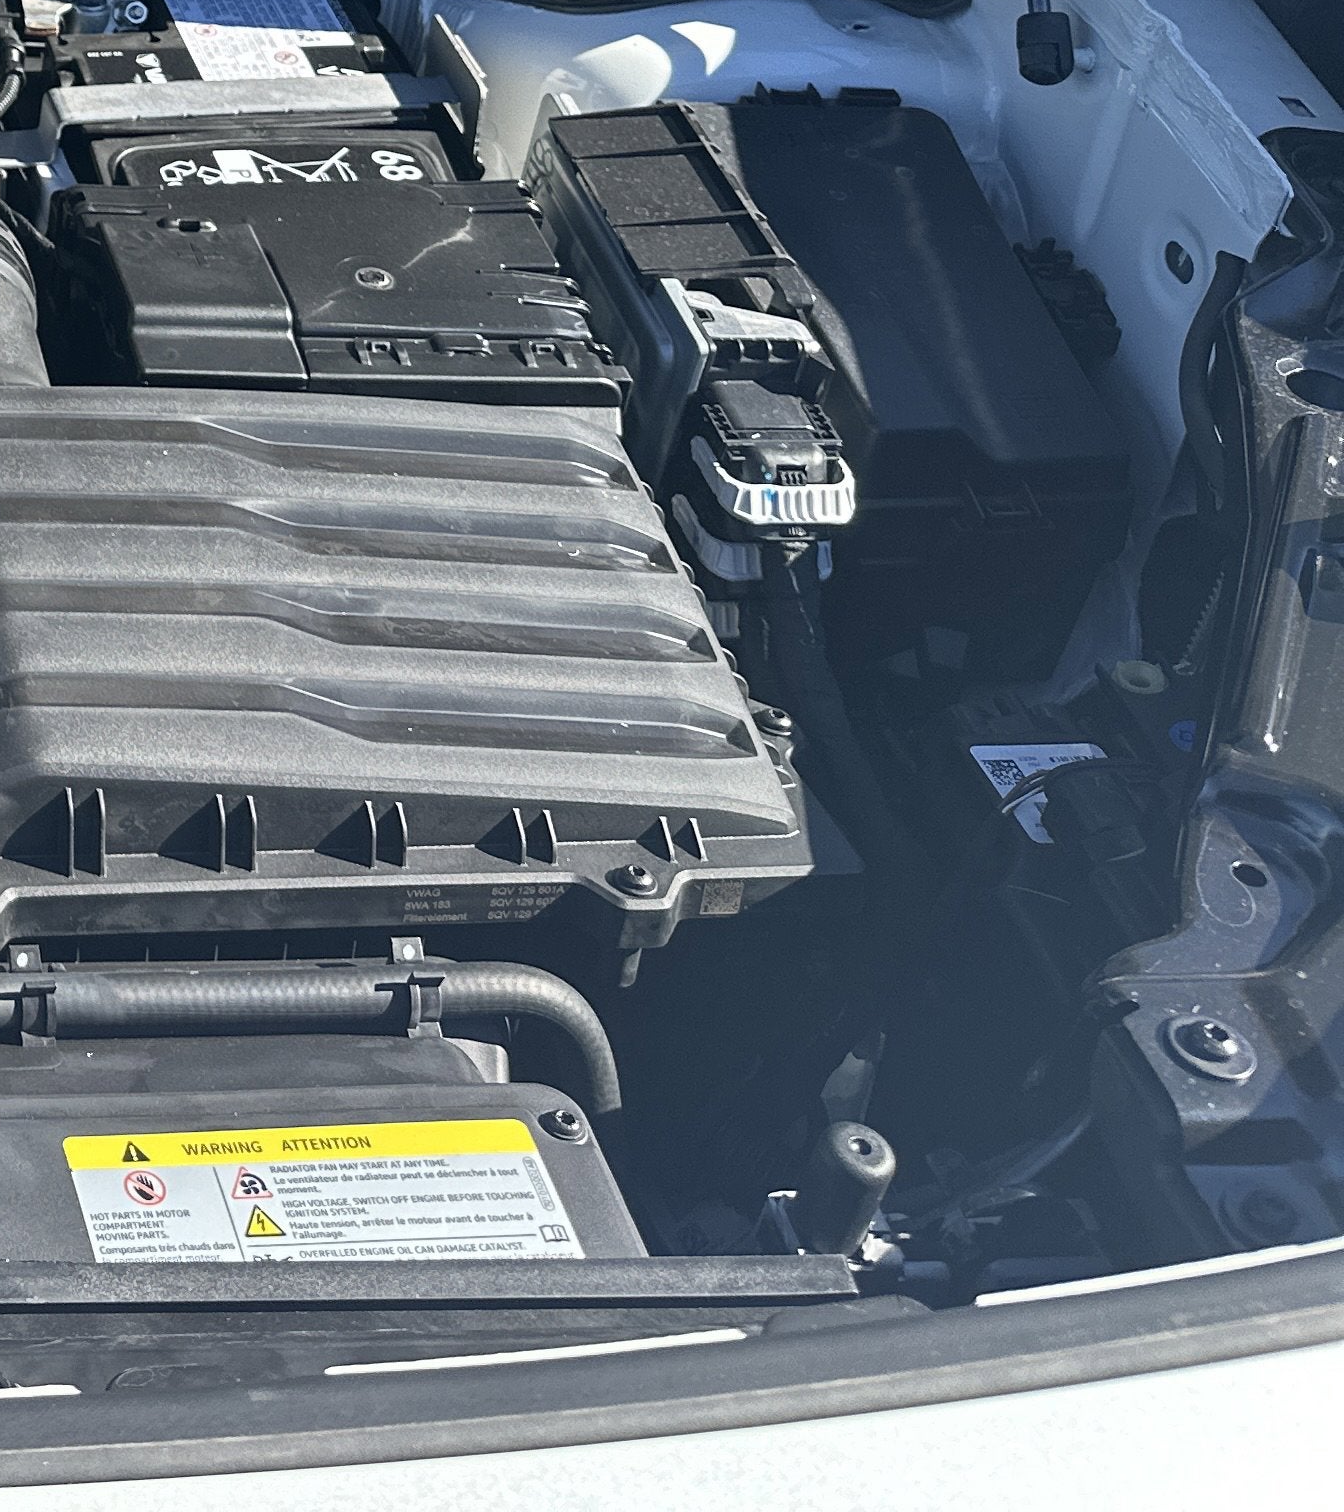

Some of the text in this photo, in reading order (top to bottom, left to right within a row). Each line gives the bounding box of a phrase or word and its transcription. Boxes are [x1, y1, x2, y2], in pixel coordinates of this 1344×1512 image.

[371, 150, 423, 181] 68
[181, 1135, 372, 1156] WARNING ATTENTION
[269, 1164, 317, 1173] RADIATOR
[318, 1162, 339, 1172] FAN
[339, 1161, 359, 1171] MAY
[360, 1160, 389, 1170] START
[390, 1160, 402, 1169] AT
[403, 1159, 422, 1168] ANY
[273, 1176, 286, 1185] Le
[287, 1173, 339, 1184] ventilateur
[340, 1173, 353, 1182] de
[355, 1171, 398, 1182] radiateur
[400, 1170, 422, 1182] peut
[424, 1171, 435, 1179] se
[498, 1168, 519, 1176] tout
[282, 1191, 535, 1208] HIGH SWITCH OFF ENGINE BEFORE TOUCHING
[90, 1209, 191, 1221] HOT PARTS IN MOTOR
[285, 1208, 329, 1218] IGNITION
[289, 1221, 319, 1230] Haute
[396, 1216, 406, 1226] le
[407, 1215, 443, 1225] moteur
[444, 1214, 472, 1224] avant
[474, 1213, 486, 1223] de
[487, 1212, 525, 1222] toucher
[96, 1232, 136, 1242] MOVING
[99, 1241, 236, 1256] Composants très chauds dans
[299, 1248, 357, 1259] OVERFILLED
[358, 1246, 395, 1257] ENGINE
[397, 1245, 413, 1255] OIL
[414, 1244, 435, 1254] CAN
[436, 1243, 477, 1254] DAMAGE
